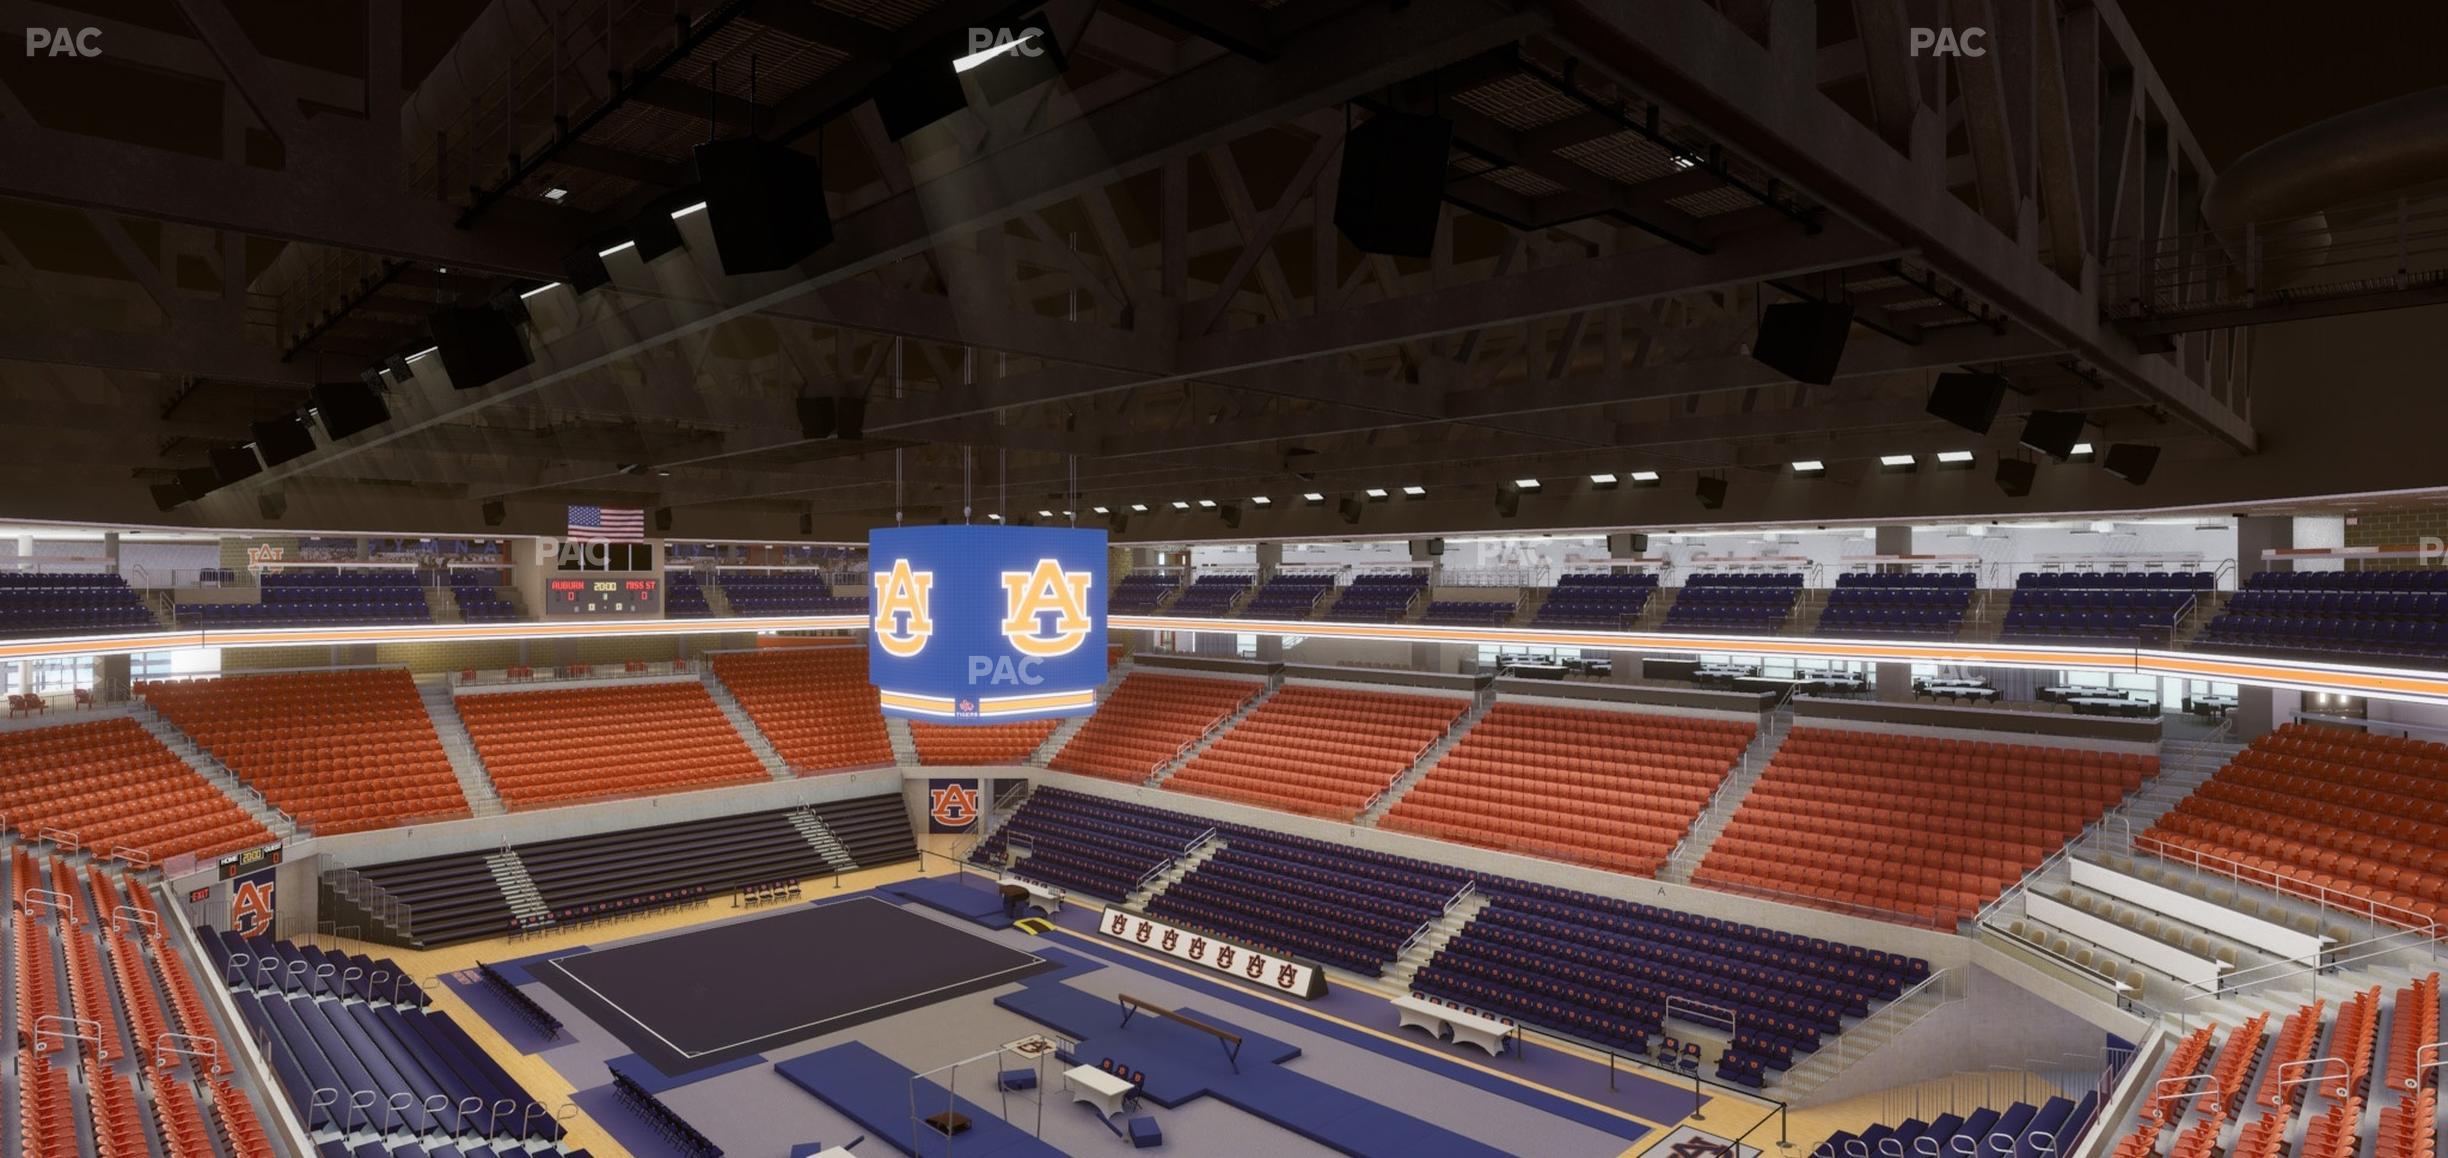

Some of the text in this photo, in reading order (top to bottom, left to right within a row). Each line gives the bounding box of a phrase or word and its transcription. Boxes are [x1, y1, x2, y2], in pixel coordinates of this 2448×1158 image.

[552, 581, 584, 590] AUBURN
[645, 581, 656, 590] ST
[263, 843, 281, 852] GUEST
[220, 856, 238, 865] HOME
[191, 888, 209, 902] EXIT
